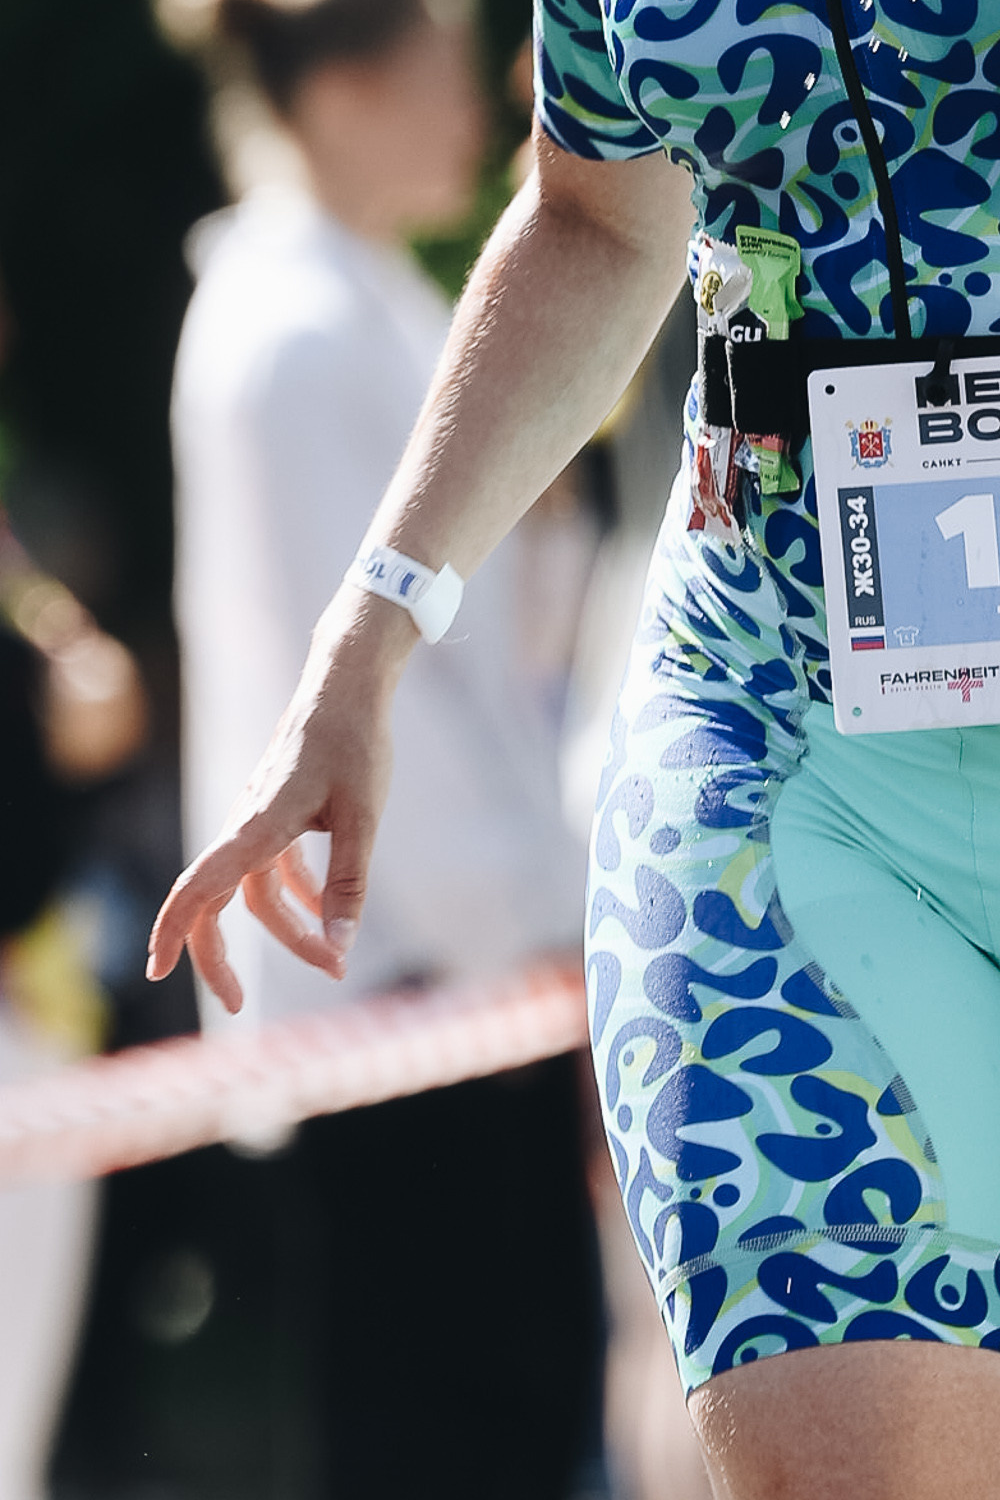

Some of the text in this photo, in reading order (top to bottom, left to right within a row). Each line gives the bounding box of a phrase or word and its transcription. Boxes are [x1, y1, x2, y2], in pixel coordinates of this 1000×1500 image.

[730, 325, 762, 342] GU
[922, 458, 962, 469] САНКТ
[847, 495, 875, 597] Ж30-34
[855, 615, 876, 626] RUS
[880, 665, 1000, 685] FAHRENHEIT
